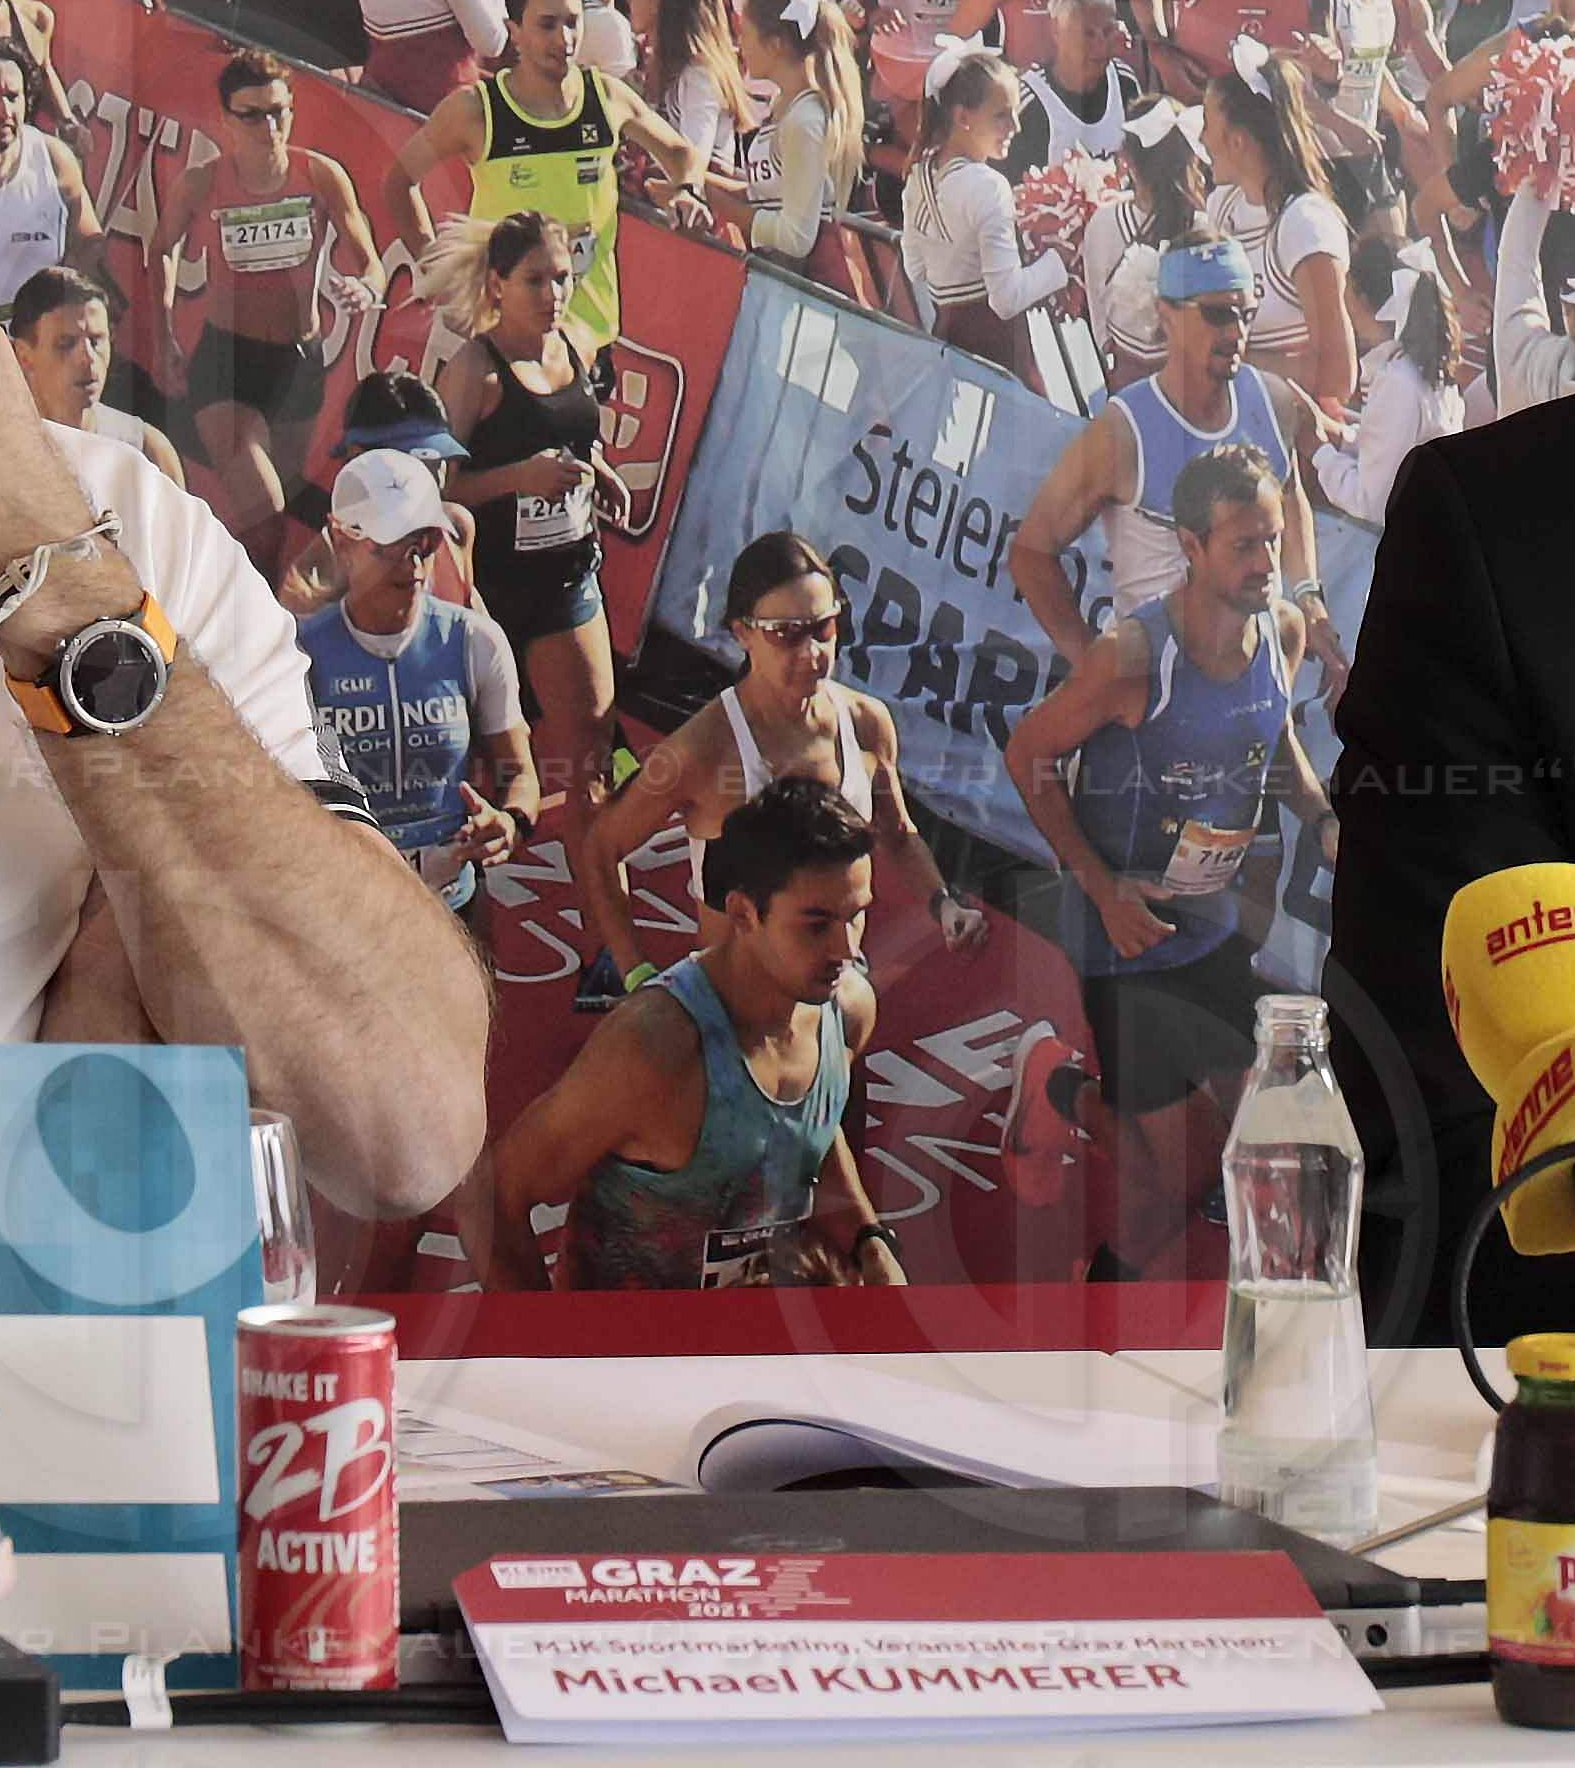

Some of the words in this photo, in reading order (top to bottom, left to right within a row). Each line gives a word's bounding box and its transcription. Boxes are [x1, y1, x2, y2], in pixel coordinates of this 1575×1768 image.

[236, 221, 296, 245] 27174
[240, 1367, 306, 1404] SHAKE
[311, 1369, 338, 1402] IT
[244, 1395, 392, 1522] 2B
[255, 1531, 379, 1576] ACTIVE
[592, 1559, 761, 1587] GRAZ
[564, 1587, 722, 1605] MARATHON
[687, 1602, 751, 1619] 2021
[609, 1638, 862, 1658] Sportmarketing,
[863, 1637, 1049, 1653] Veranstalter
[1057, 1637, 1124, 1652] Graz
[552, 1667, 799, 1695] Michael
[812, 1663, 1190, 1694] KUMMERER
